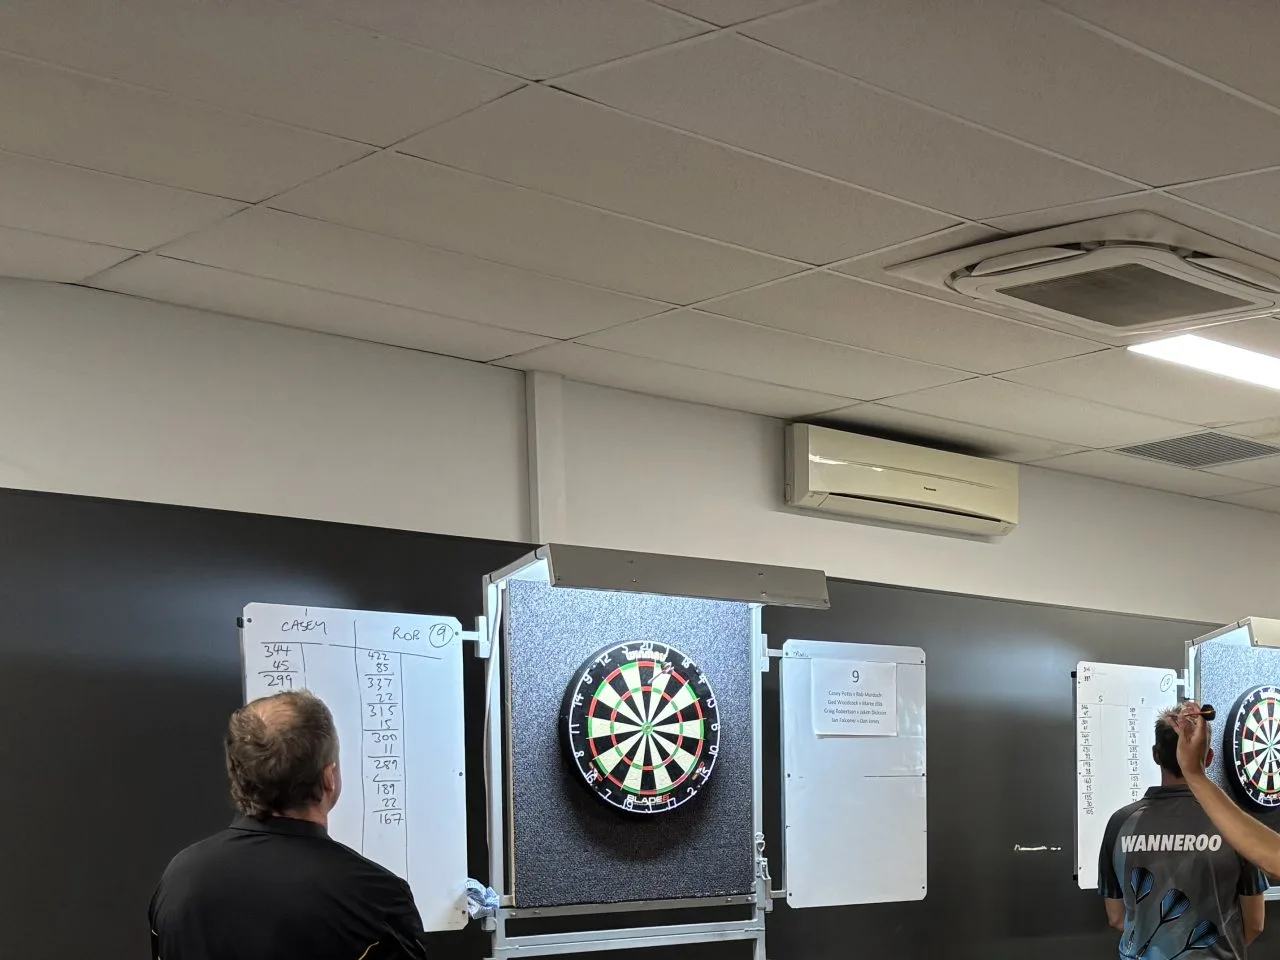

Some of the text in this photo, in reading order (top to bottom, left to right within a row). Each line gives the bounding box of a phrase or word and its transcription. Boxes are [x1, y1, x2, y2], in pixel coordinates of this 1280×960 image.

[281, 619, 328, 635] CASEY
[392, 629, 421, 642] ROB
[263, 644, 292, 657] 344
[367, 650, 390, 662] 422
[272, 659, 290, 671] 45
[376, 662, 390, 673] 85
[265, 674, 293, 687] 299
[367, 677, 393, 690] 337
[852, 670, 860, 684] 9
[377, 692, 394, 703] 22
[368, 704, 394, 717] 315
[380, 718, 391, 730] 15
[373, 758, 399, 770] 289
[376, 783, 395, 796] 189
[381, 798, 397, 808] 22
[379, 812, 404, 825] 167
[1121, 834, 1222, 853] WANNEROO
